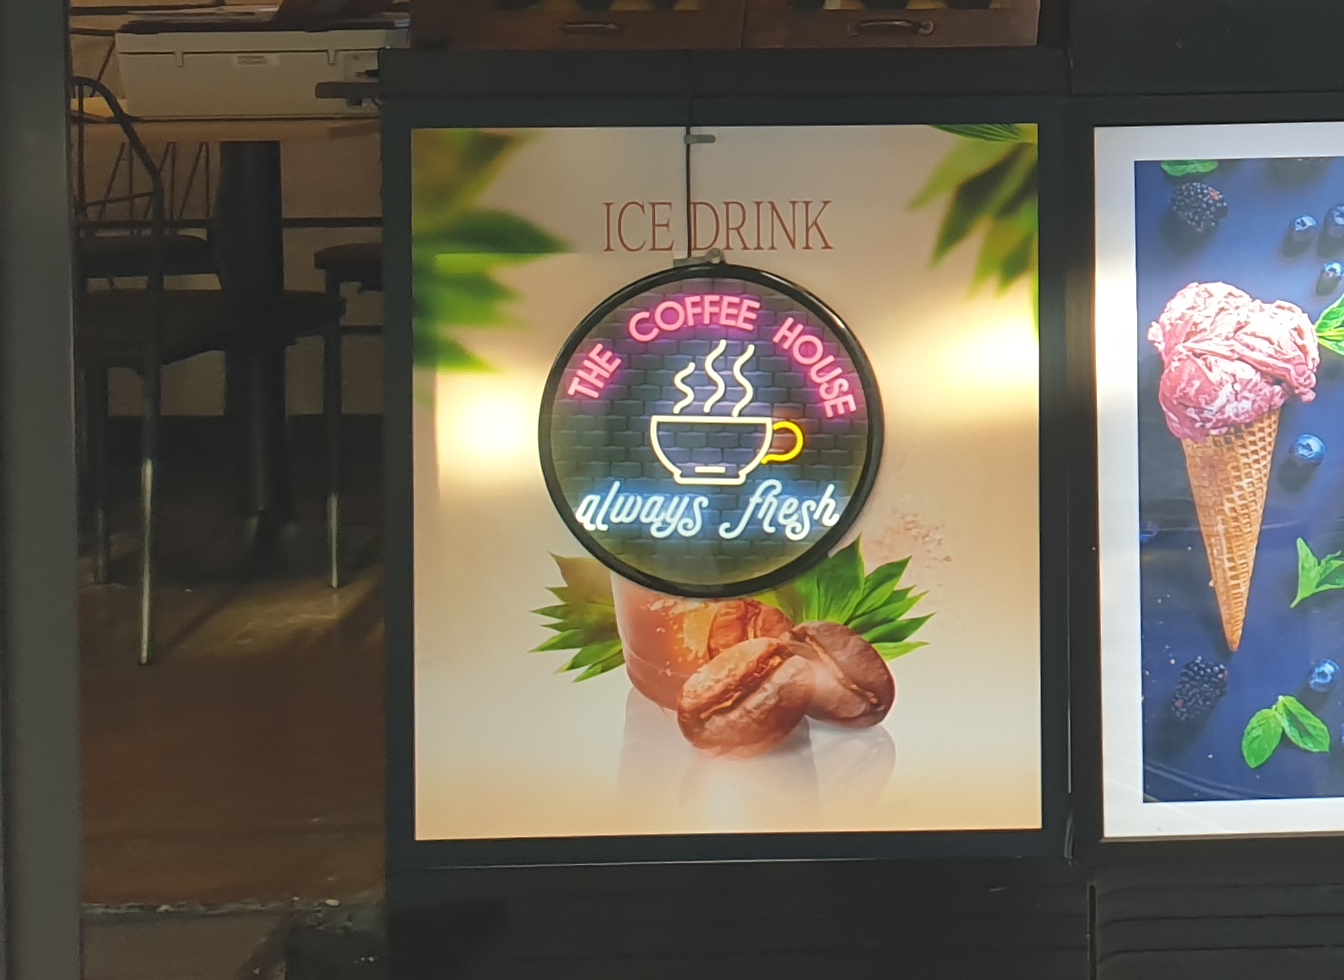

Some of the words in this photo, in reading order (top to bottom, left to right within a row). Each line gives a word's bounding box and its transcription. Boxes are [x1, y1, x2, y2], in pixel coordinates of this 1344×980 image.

[602, 201, 675, 254] ICE
[689, 198, 834, 252] DRINK
[567, 342, 622, 401] THE
[627, 293, 762, 344] COFFEE
[772, 316, 857, 420] HOUSE
[574, 479, 710, 538] always
[718, 477, 843, 542] fresh
